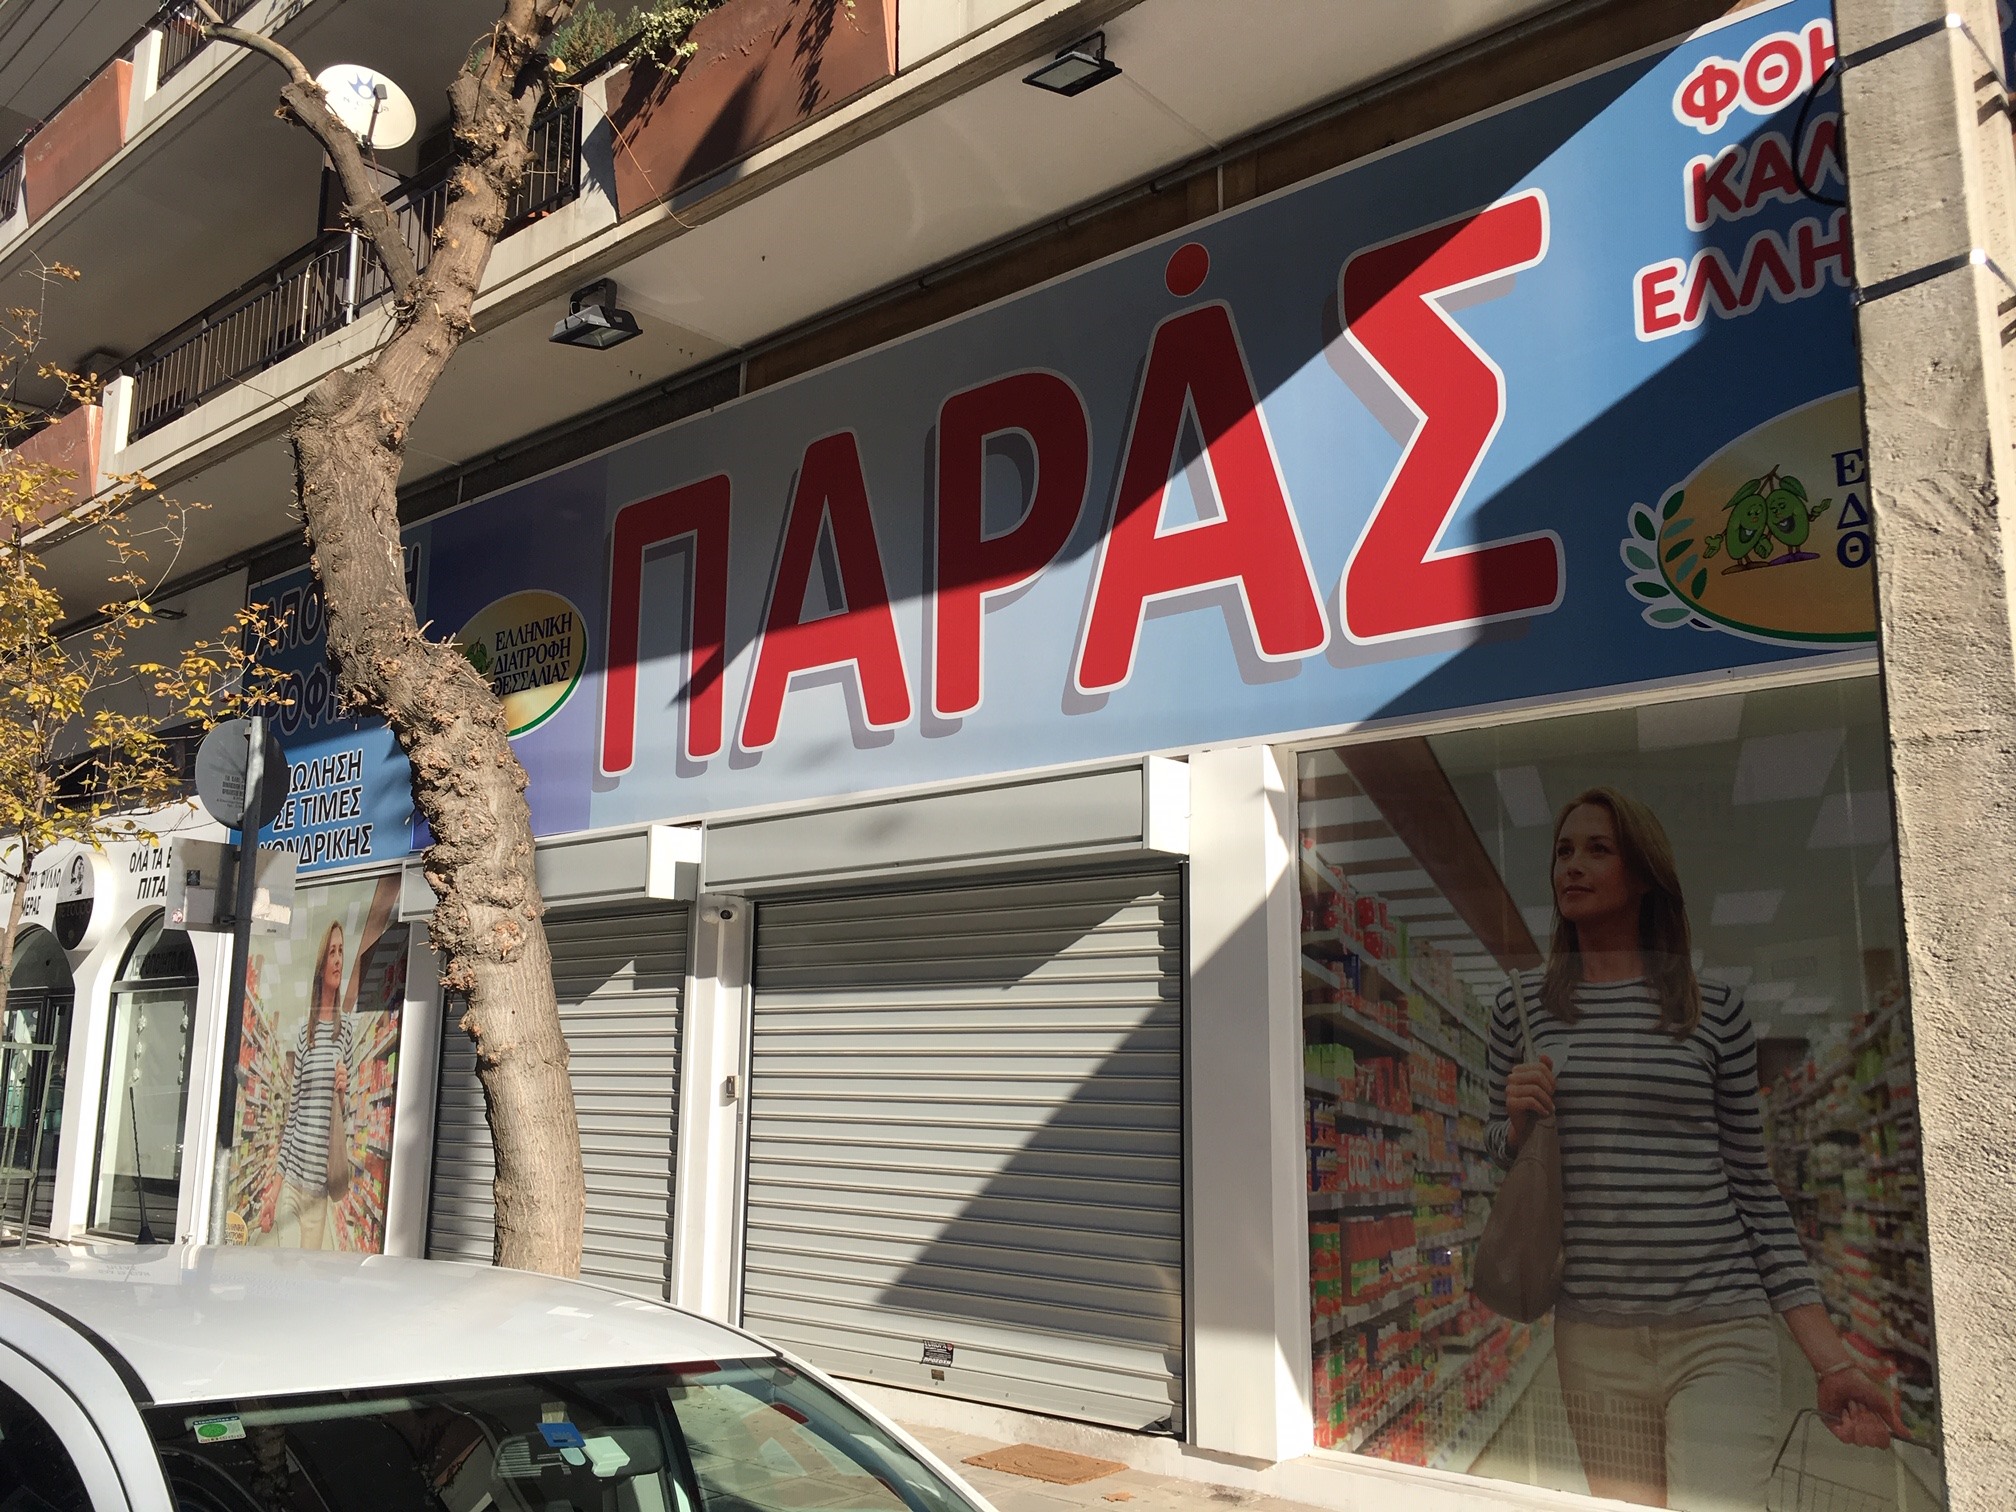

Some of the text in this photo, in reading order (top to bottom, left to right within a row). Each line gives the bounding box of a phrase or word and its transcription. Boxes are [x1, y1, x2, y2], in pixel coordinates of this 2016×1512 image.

[495, 612, 572, 652] ΕΛΛΗΝΙΚΗ
[493, 637, 571, 676] ΔΙΑΤΡΟΦΗ
[492, 660, 570, 697] ΘΕΣΣΑΛΙΑΣ
[288, 750, 362, 793] ΩΛΗΣΗ
[300, 787, 362, 826] ΤΙΜΕΣ
[151, 847, 163, 870] ΤΑ
